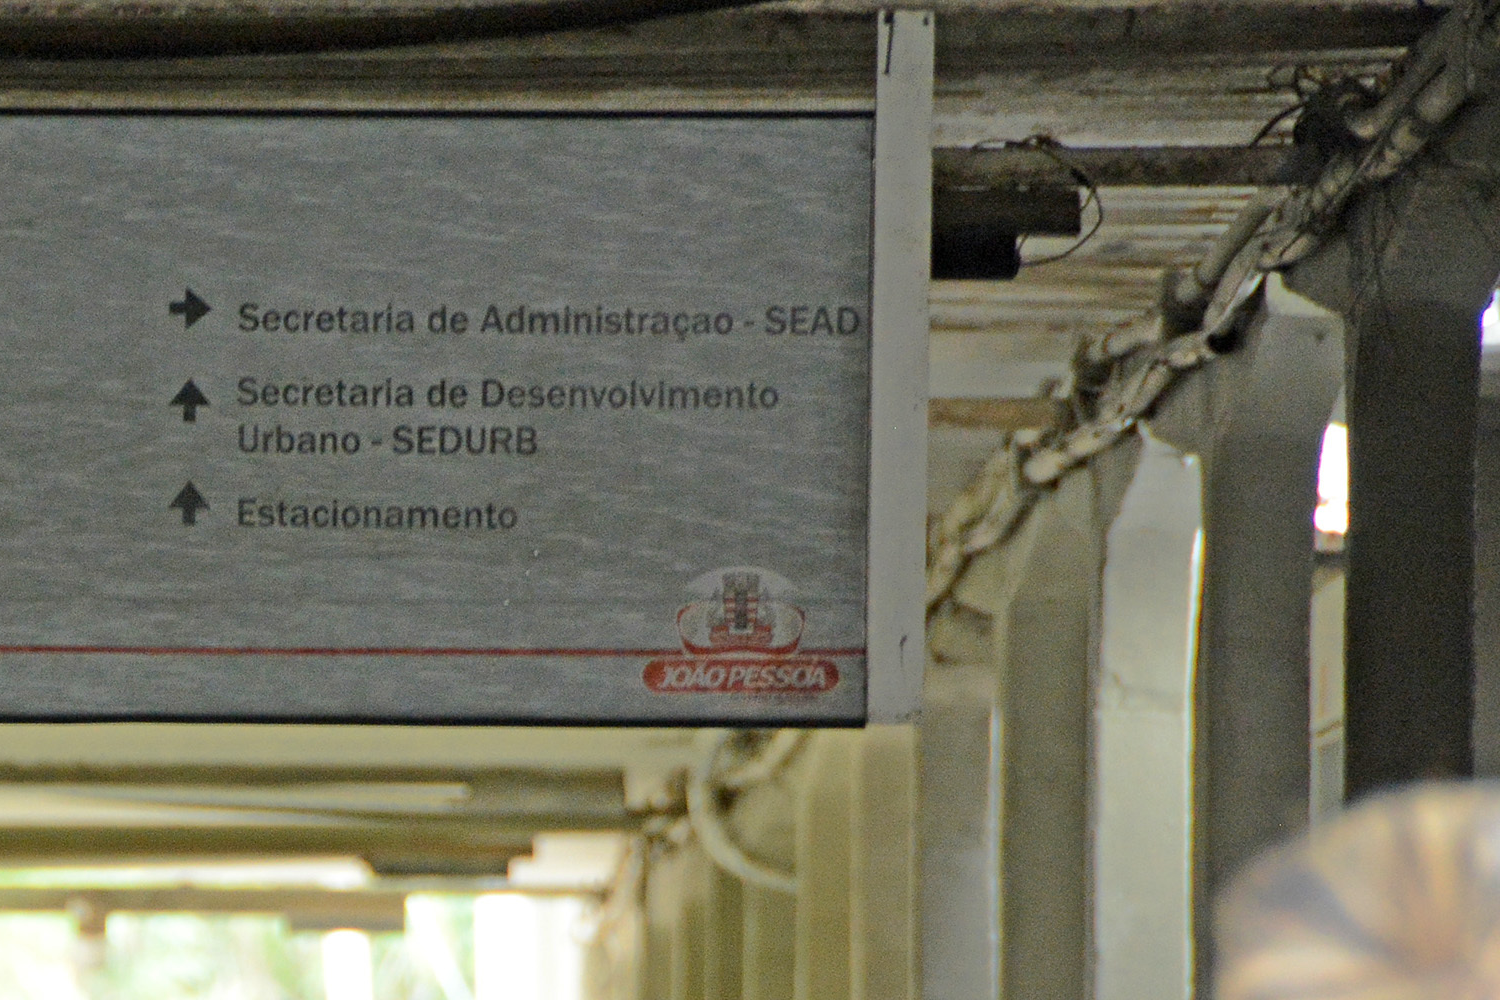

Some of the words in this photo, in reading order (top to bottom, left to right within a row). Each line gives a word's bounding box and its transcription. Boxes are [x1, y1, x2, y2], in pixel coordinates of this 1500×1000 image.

[239, 303, 414, 333] Secretaria
[428, 306, 468, 334] de
[766, 306, 860, 336] SEAD
[238, 377, 414, 407] Secretaria
[427, 379, 468, 408] de
[482, 379, 778, 408] Desenvolvimento
[239, 425, 360, 454] Urbano
[393, 425, 538, 455] SEDURB
[238, 499, 517, 529] Estacionamento
[728, 665, 827, 688] PESSOA
